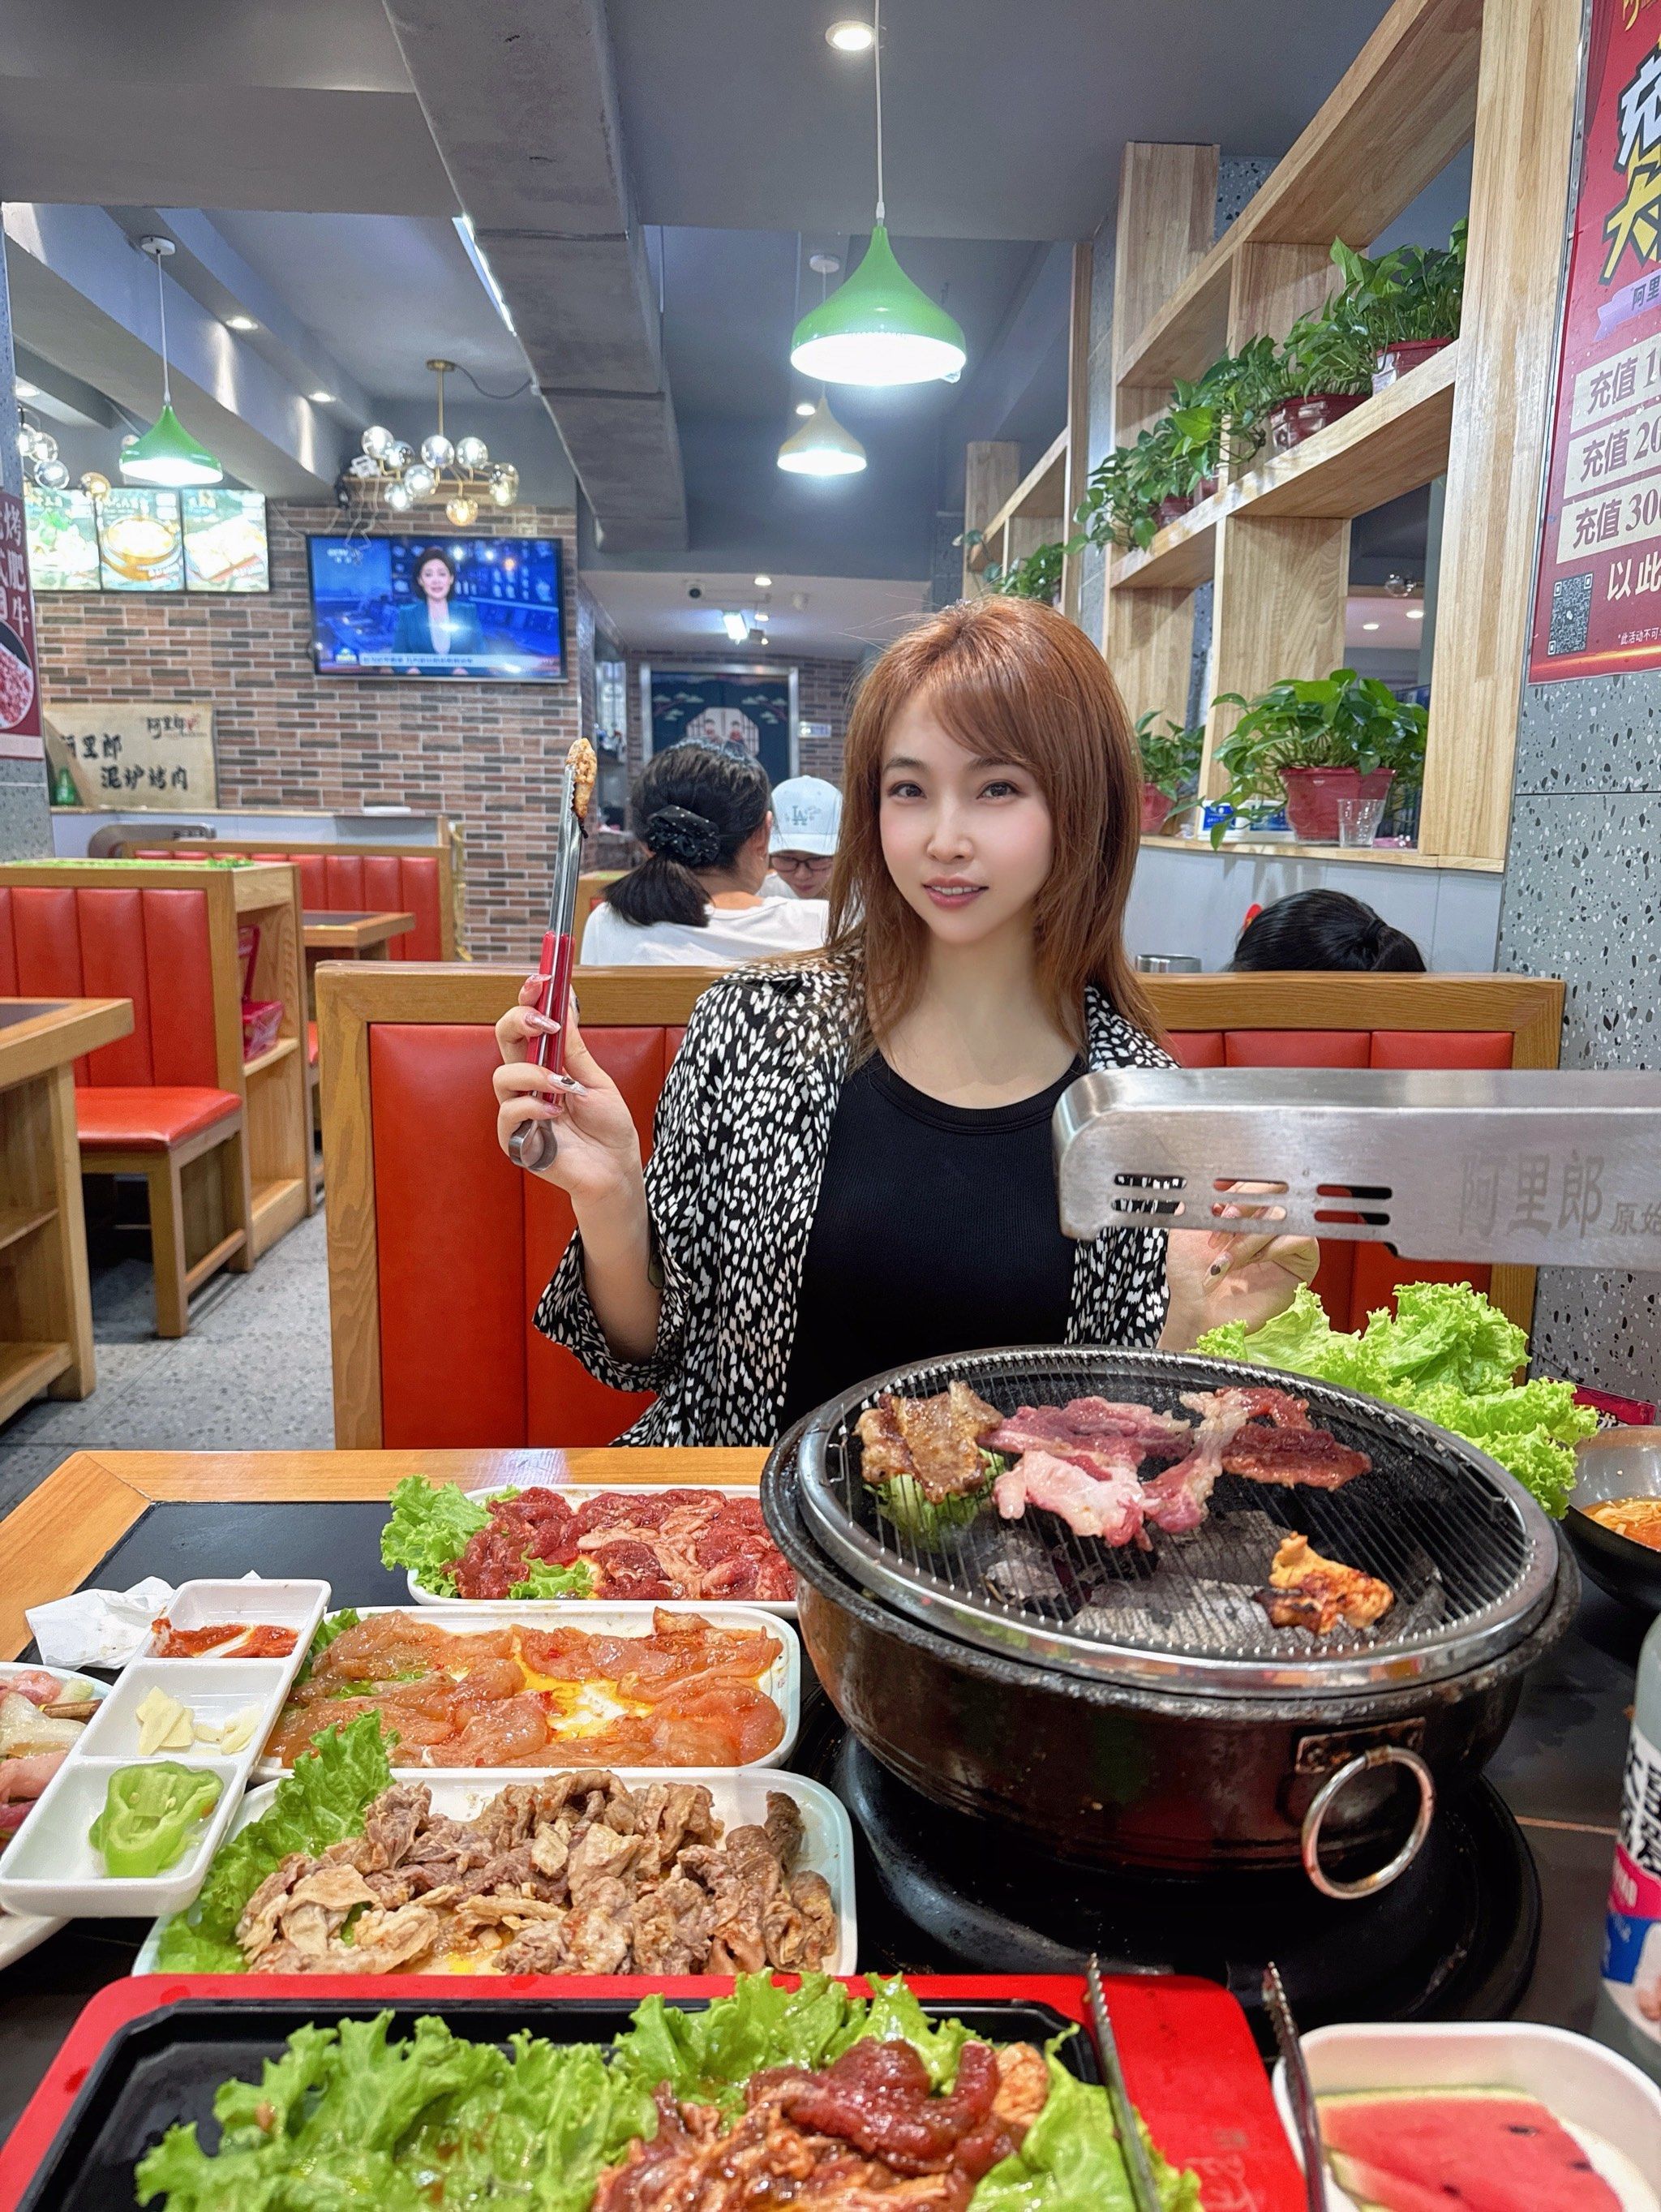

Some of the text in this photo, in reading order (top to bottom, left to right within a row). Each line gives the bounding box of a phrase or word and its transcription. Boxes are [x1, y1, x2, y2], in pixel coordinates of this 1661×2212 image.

[1633, 276, 1661, 311] 阿里
[1607, 551, 1661, 601] 以此
[101, 764, 187, 790] 泥炉烤肉
[1459, 1149, 1605, 1239] 阿里郎
